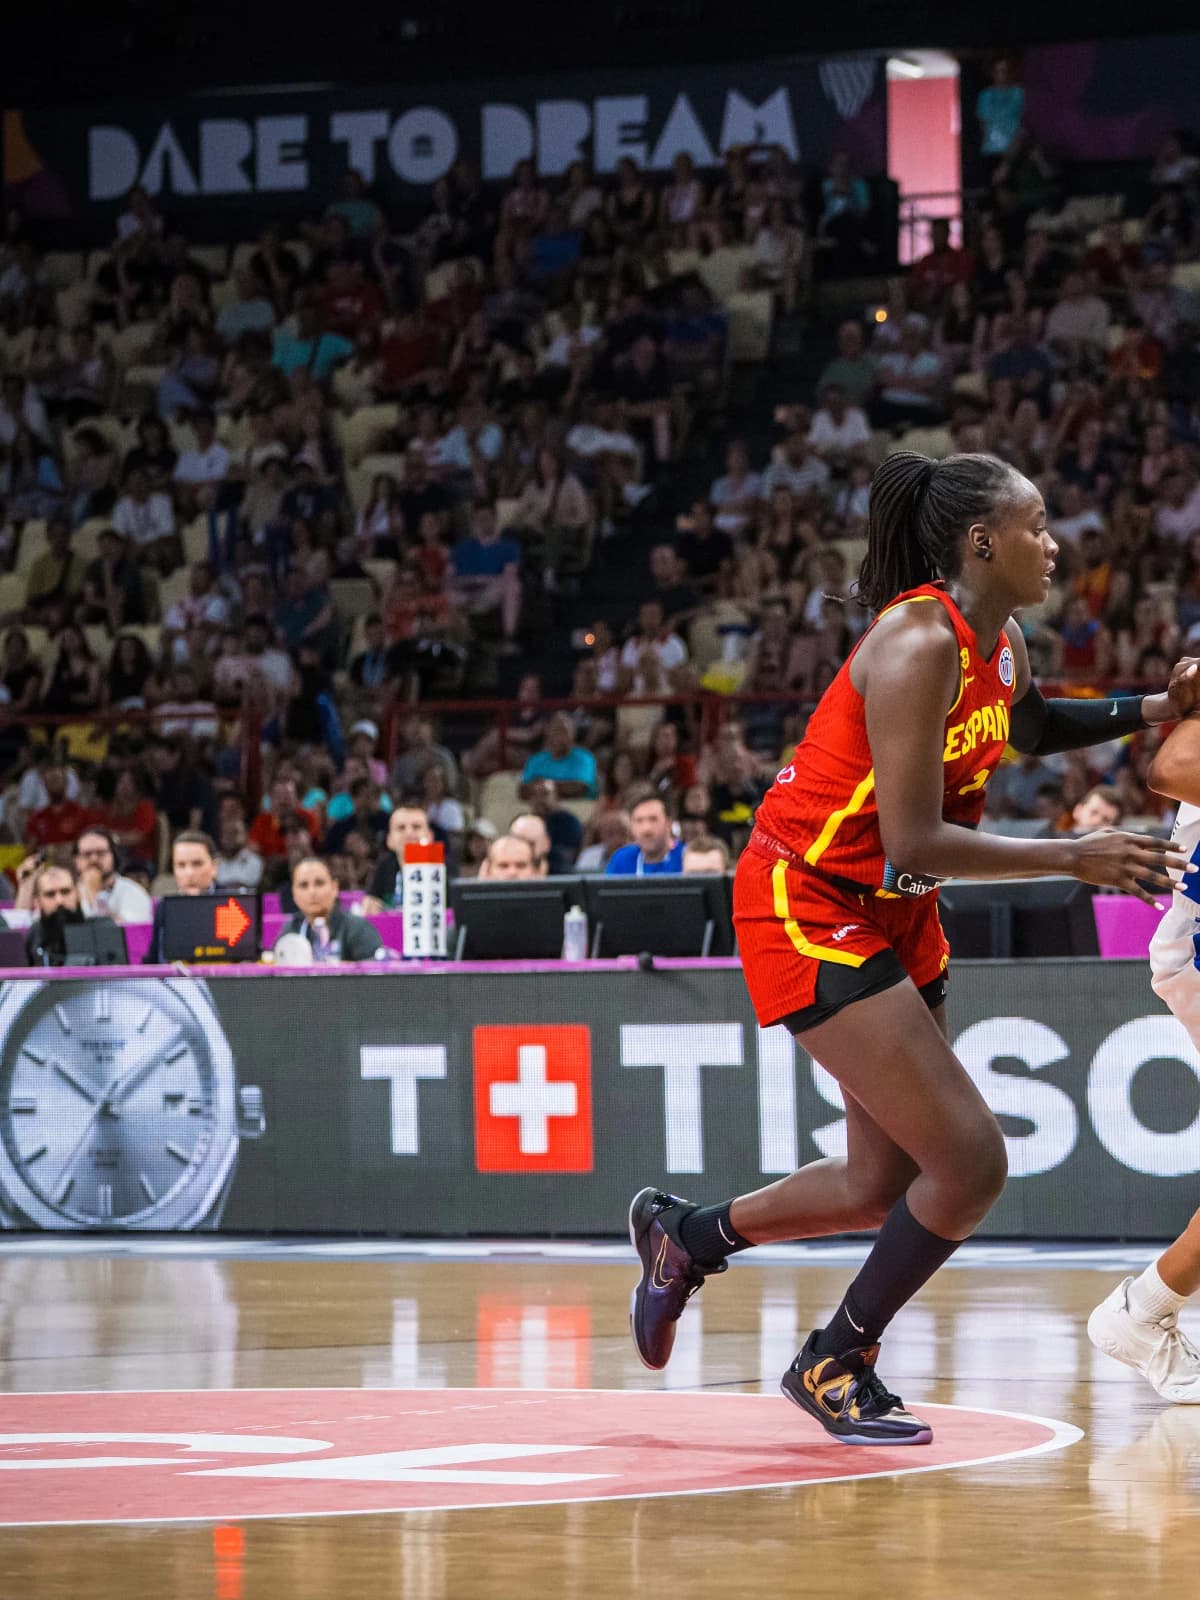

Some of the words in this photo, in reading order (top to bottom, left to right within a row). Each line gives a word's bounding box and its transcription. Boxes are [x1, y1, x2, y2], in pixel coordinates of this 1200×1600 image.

[88, 114, 308, 201] DARE
[330, 106, 459, 184] TO
[480, 86, 799, 180] DREAM
